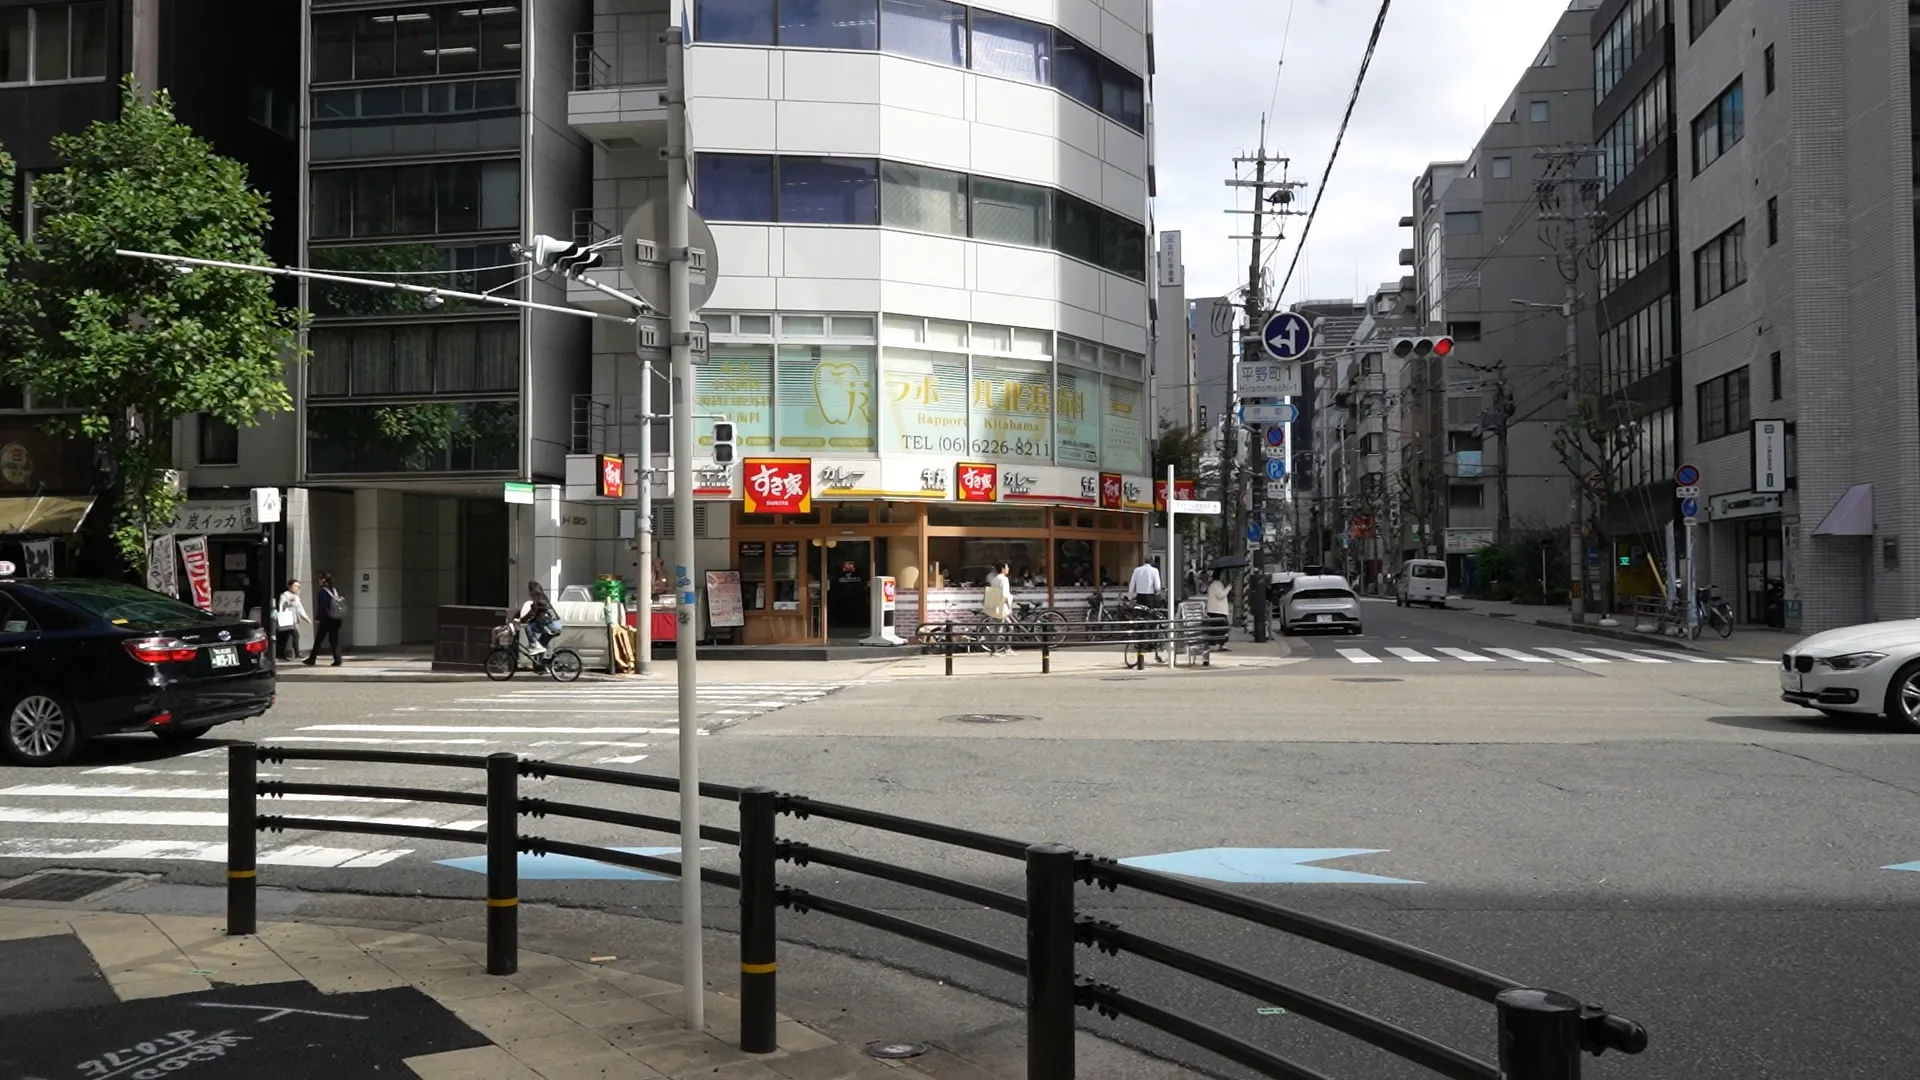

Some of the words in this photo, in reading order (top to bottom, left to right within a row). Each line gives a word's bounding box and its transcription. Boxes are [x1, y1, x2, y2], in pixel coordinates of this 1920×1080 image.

[901, 434, 934, 450] TEL
[939, 436, 967, 453] (06)
[972, 441, 1050, 457] 6226-8211
[750, 464, 804, 500] すき家
[822, 466, 866, 480] カレー
[962, 467, 993, 491] すき家
[1004, 472, 1038, 486] カレー
